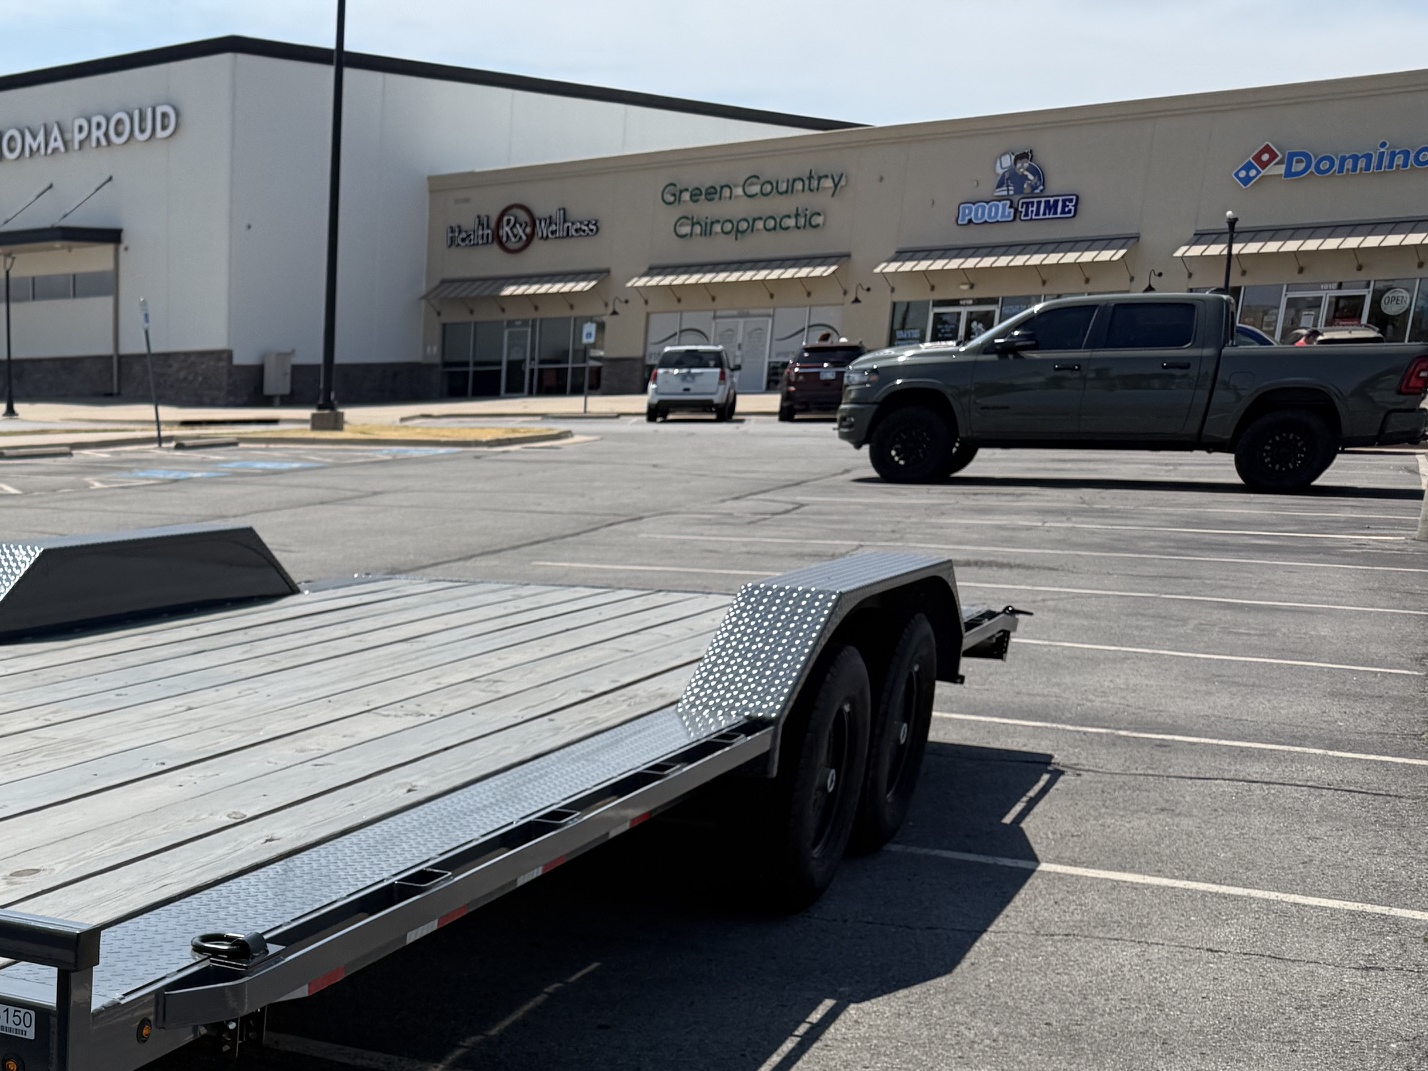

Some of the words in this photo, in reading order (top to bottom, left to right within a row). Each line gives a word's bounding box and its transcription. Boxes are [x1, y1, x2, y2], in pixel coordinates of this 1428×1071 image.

[73, 104, 179, 151] PROUD
[661, 182, 734, 206] Green
[742, 169, 845, 198] Country
[673, 207, 823, 241] Chiropractic
[957, 200, 1015, 225] POOL
[1018, 194, 1078, 221] TIME
[446, 214, 494, 248] Health
[501, 215, 529, 244] Rx
[535, 207, 599, 240] Wellness
[1384, 295, 1408, 306] OPEN
